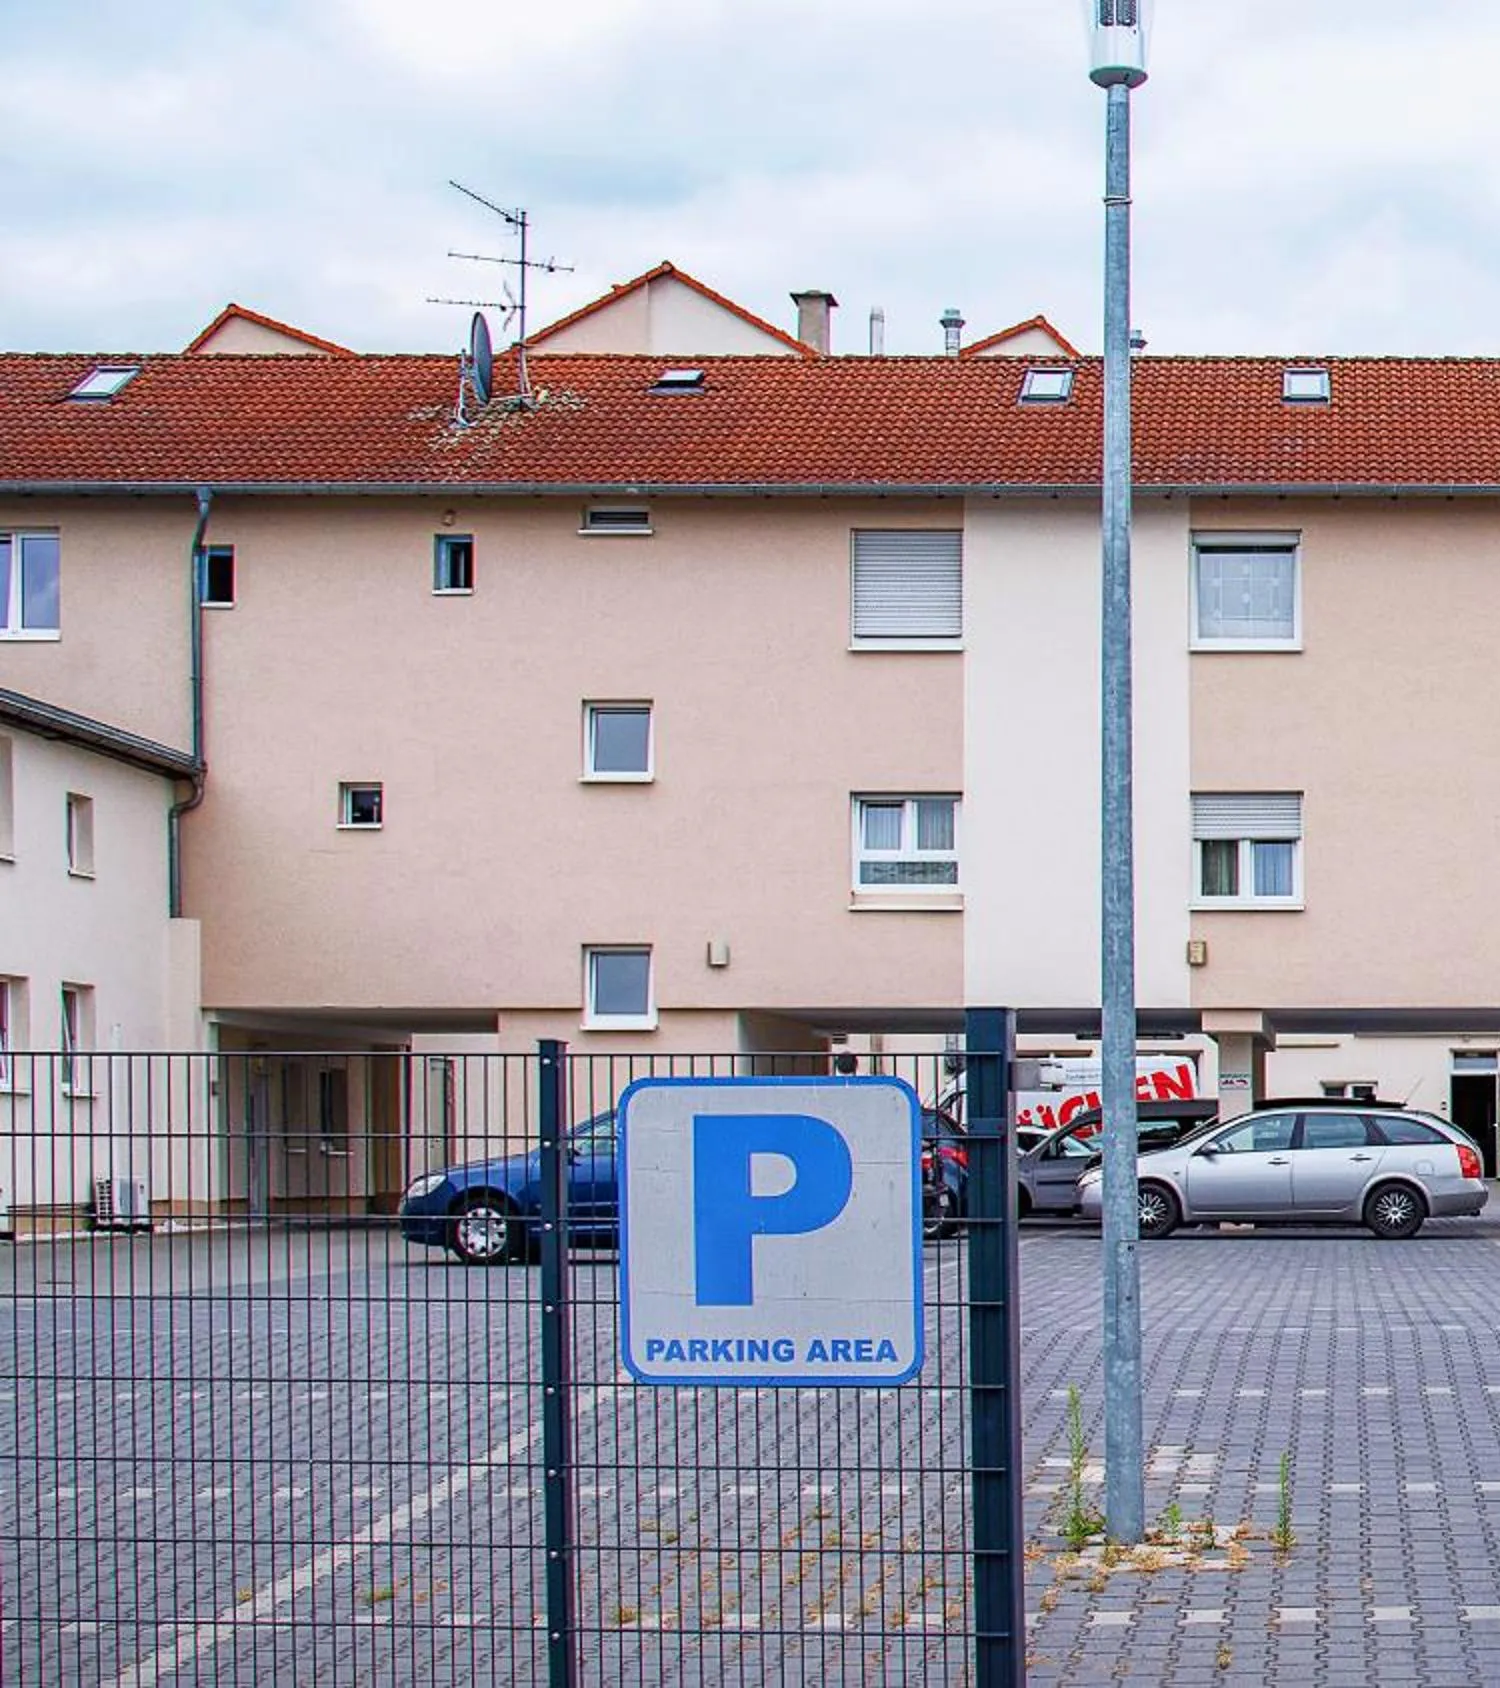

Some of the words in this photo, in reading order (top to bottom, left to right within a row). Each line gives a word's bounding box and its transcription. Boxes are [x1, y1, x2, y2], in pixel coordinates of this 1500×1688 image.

[693, 1115, 852, 1306] P
[646, 1339, 795, 1363] PARKING
[805, 1339, 899, 1363] AREA
